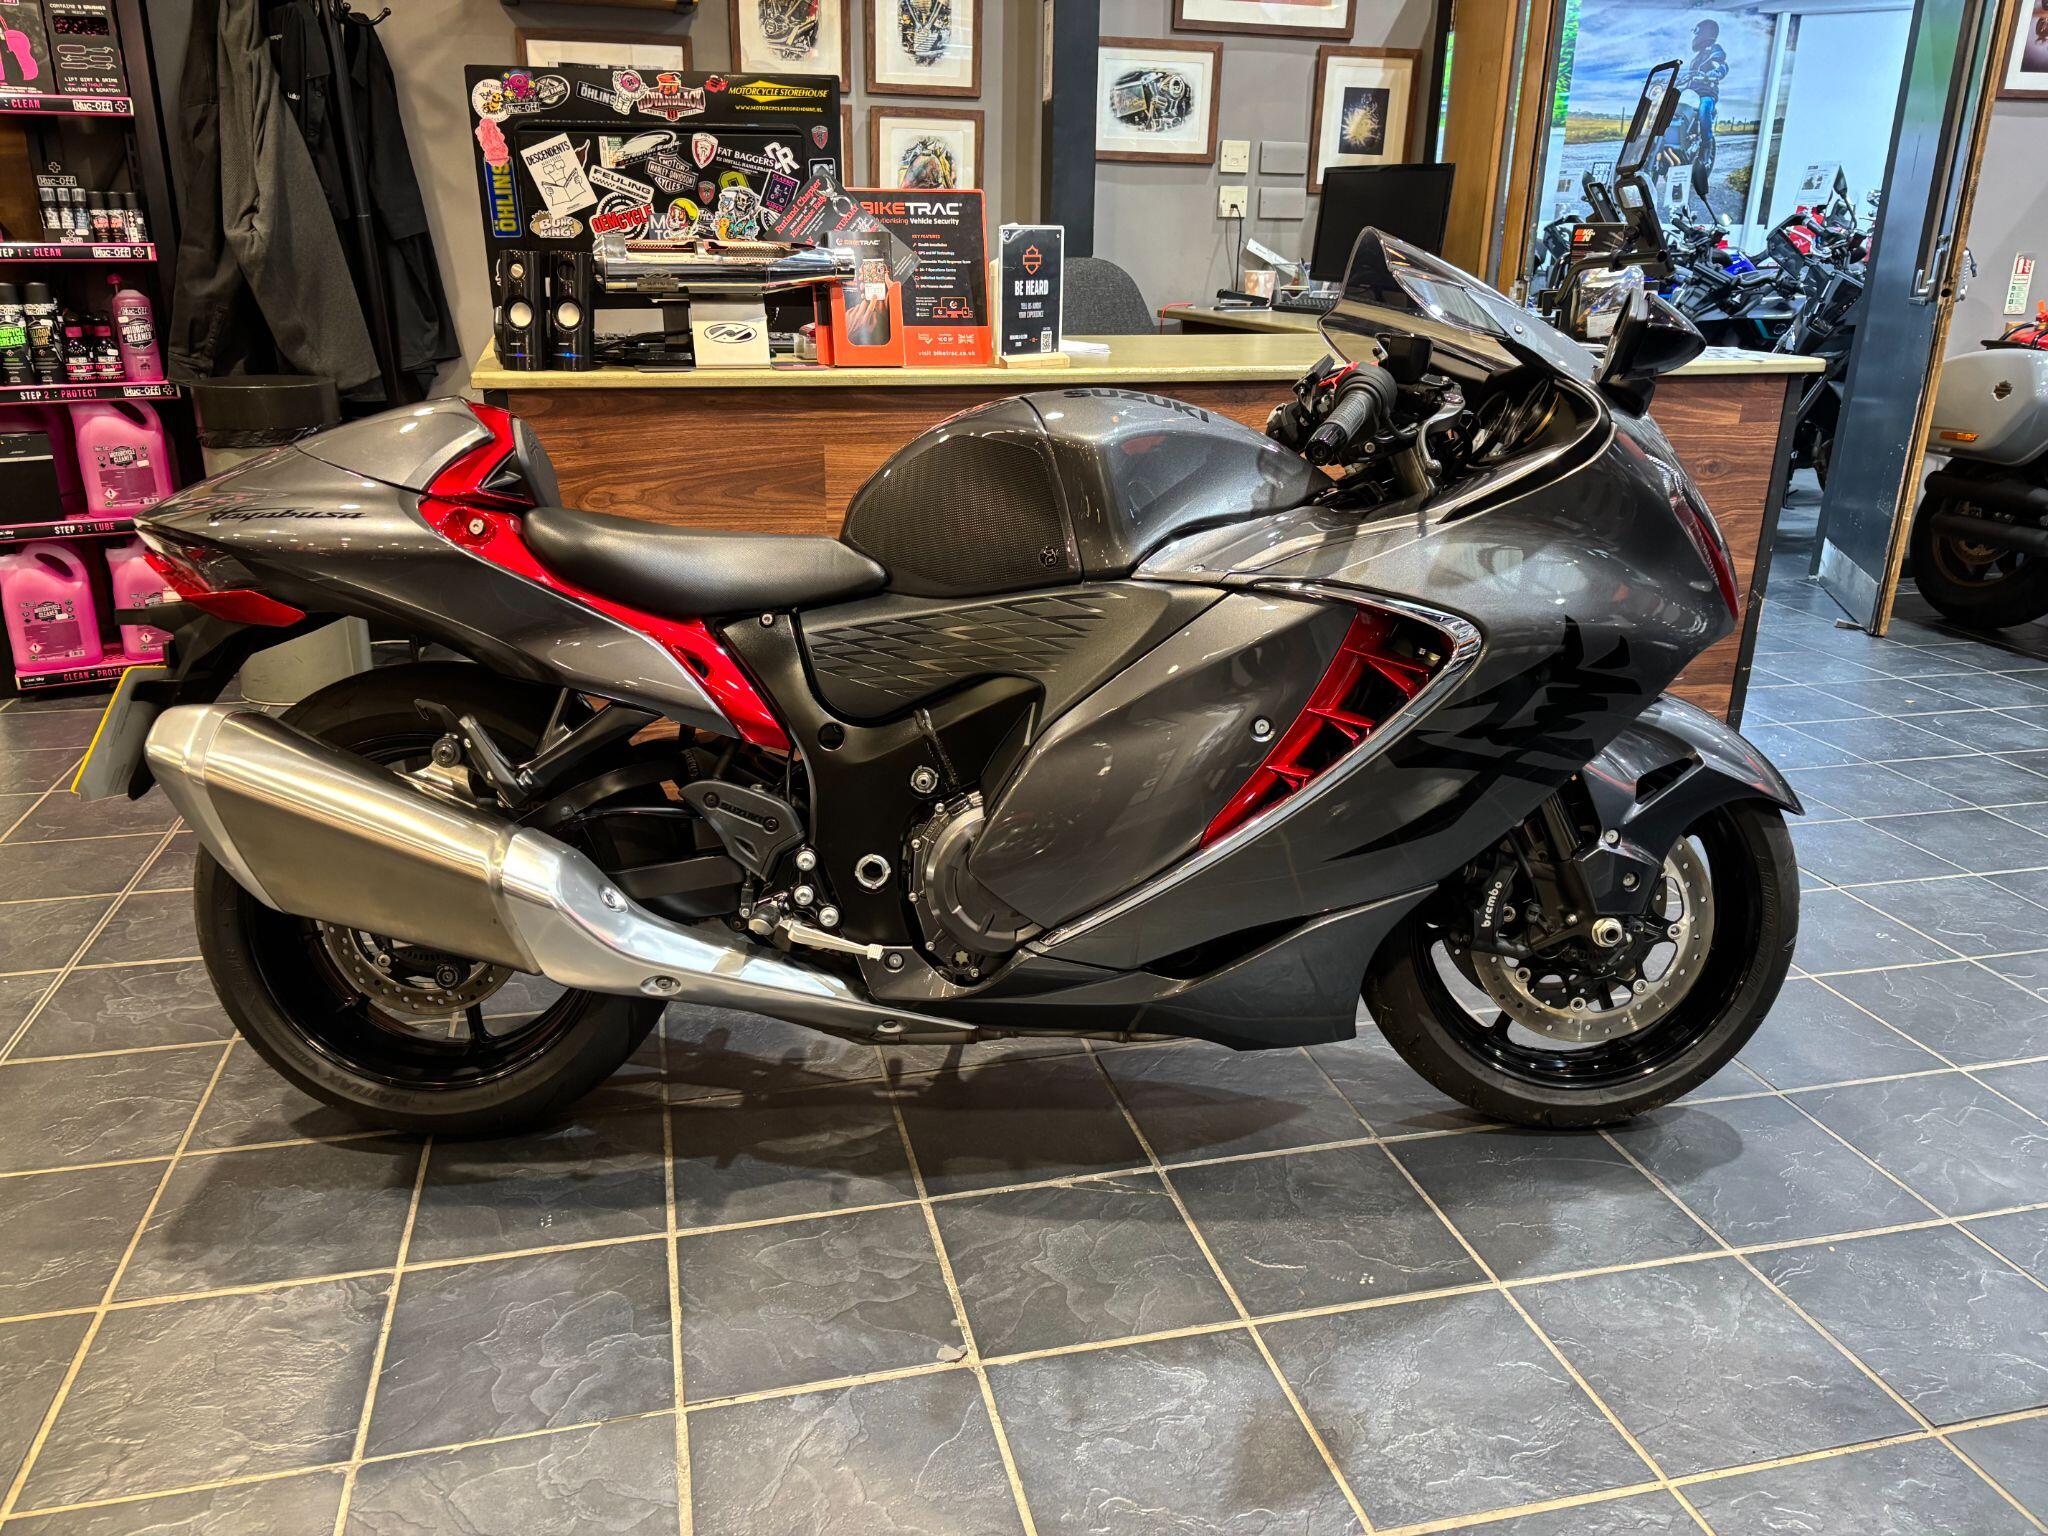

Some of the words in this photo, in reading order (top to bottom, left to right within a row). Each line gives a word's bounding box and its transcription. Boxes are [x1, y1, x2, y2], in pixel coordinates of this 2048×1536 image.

[580, 84, 616, 106] ÖHLINS
[728, 88, 778, 96] MOTORCYCLE
[780, 88, 829, 98] STOREHOUSE
[11, 99, 41, 108] CLEAN
[75, 101, 112, 112] Muc-Off
[507, 103, 539, 112] Muc-Off
[526, 141, 570, 166] DESCENDENTS
[717, 147, 732, 157] FAT
[734, 151, 774, 167] BAGGERS
[662, 159, 688, 174] MOTOR
[40, 177, 76, 186] Muc-Off
[594, 168, 651, 194] FEULING
[650, 164, 694, 185] HARLEY-DAVIDSON
[772, 174, 796, 186] CLASSIC
[654, 176, 684, 190] CYCLES
[492, 164, 518, 232] ÖHLINS
[774, 204, 800, 234] Rutland
[796, 179, 821, 207] Chapter
[860, 202, 960, 216] BIKETRAC
[592, 204, 653, 233] OEMCYCLE
[834, 204, 858, 232] TURDAY
[934, 218, 960, 226] Security
[0, 248, 14, 257] TEP
[18, 248, 22, 256] 1
[34, 248, 62, 257] CLEAN
[95, 248, 131, 258] Muc-Off
[1014, 280, 1024, 296] BE
[1026, 279, 1049, 296] HEARD
[127, 332, 153, 342] CLEANER
[20, 391, 41, 400] STEP
[44, 391, 50, 400] 2
[61, 388, 98, 398] PROTECT
[125, 387, 161, 396] Muc-Off
[1063, 388, 1210, 424] SUZUKI
[206, 505, 369, 523] Hayabusa
[54, 525, 75, 535] STEP
[78, 525, 84, 533] 3
[94, 522, 115, 532] LUBE
[64, 671, 90, 681] CLEAN
[720, 802, 764, 823] SUZUKI
[1480, 881, 1503, 928] brembo
